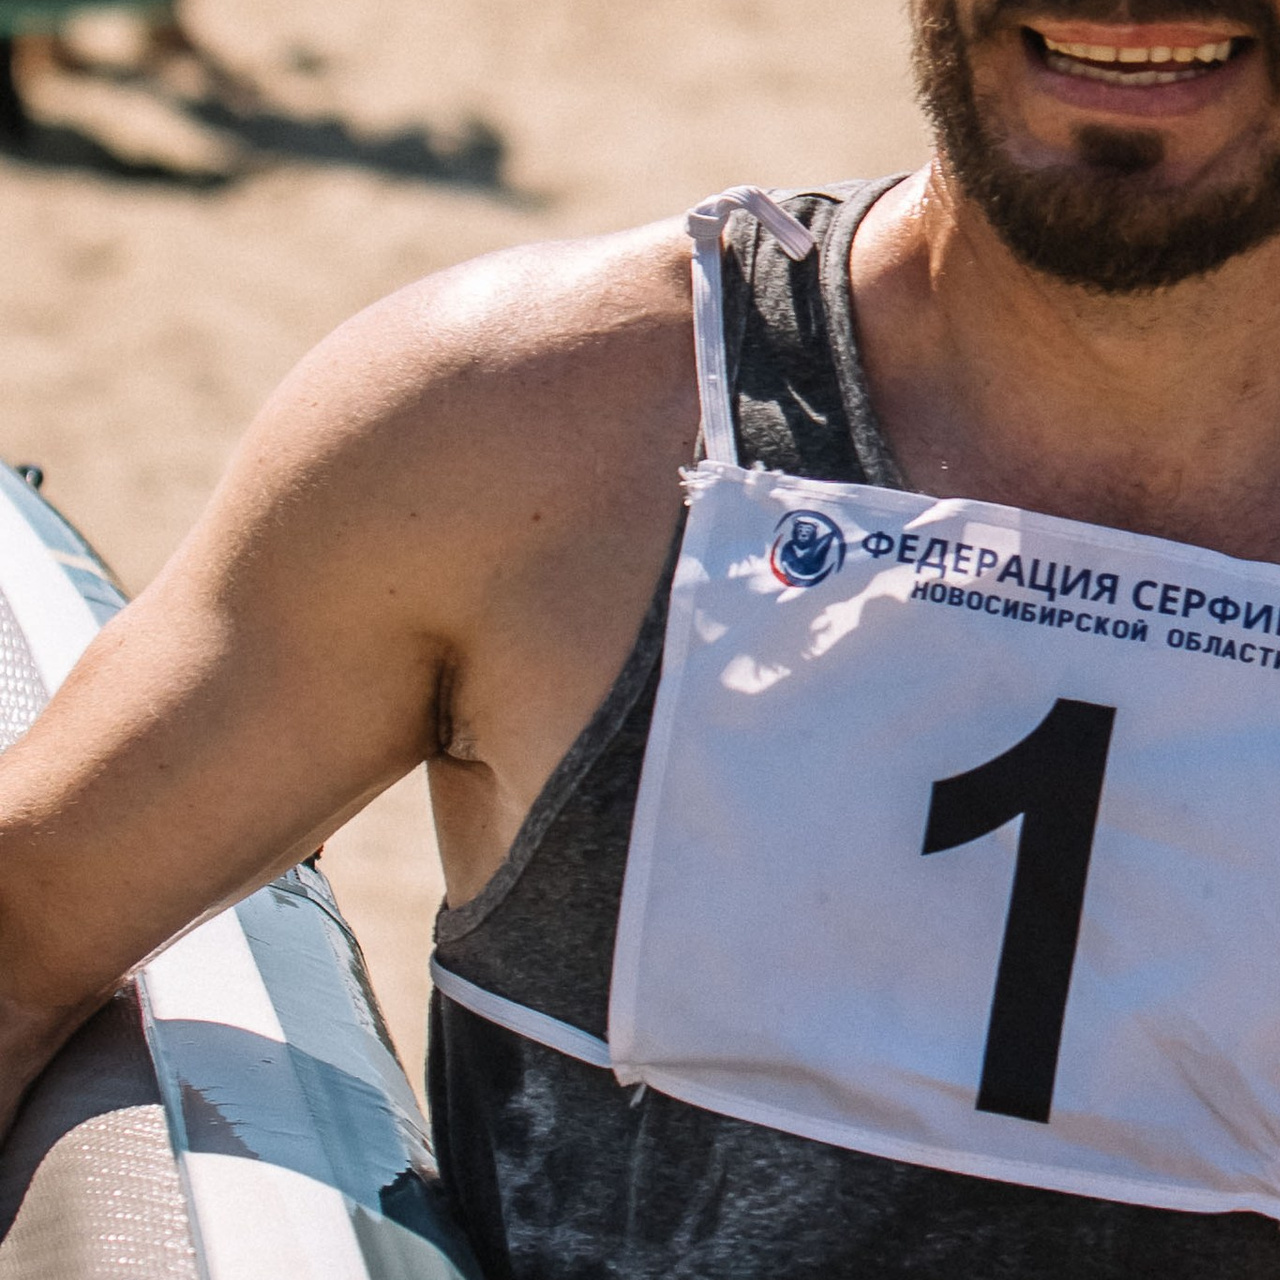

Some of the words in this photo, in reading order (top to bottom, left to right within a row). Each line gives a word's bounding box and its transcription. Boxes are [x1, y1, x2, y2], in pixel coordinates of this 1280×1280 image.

[862, 530, 1120, 604] ФЕДЕРАЦИЯ
[911, 579, 1148, 642] НОВОСИБИРСКОЙ
[921, 698, 1116, 1124] 1
